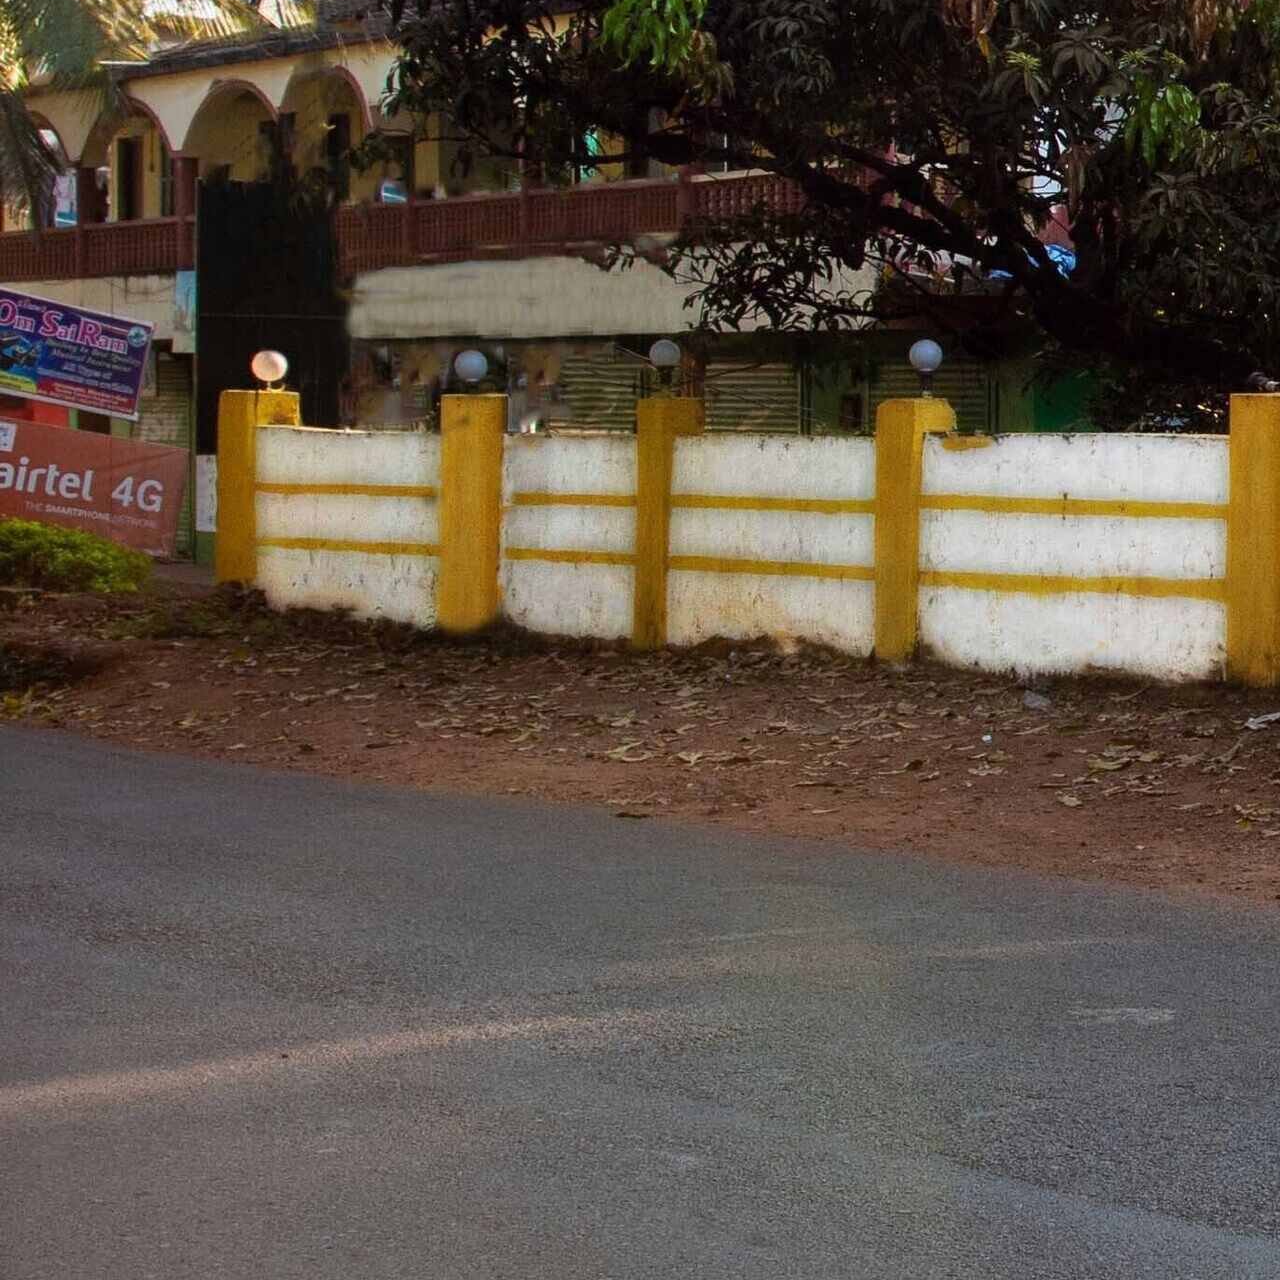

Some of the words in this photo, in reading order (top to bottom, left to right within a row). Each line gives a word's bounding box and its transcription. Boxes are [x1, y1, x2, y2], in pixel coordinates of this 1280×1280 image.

[39, 310, 77, 341] Sai
[78, 317, 128, 355] Ram
[0, 456, 94, 502] airtel
[111, 476, 164, 513] 4G
[45, 503, 111, 522] SMARTPHONE
